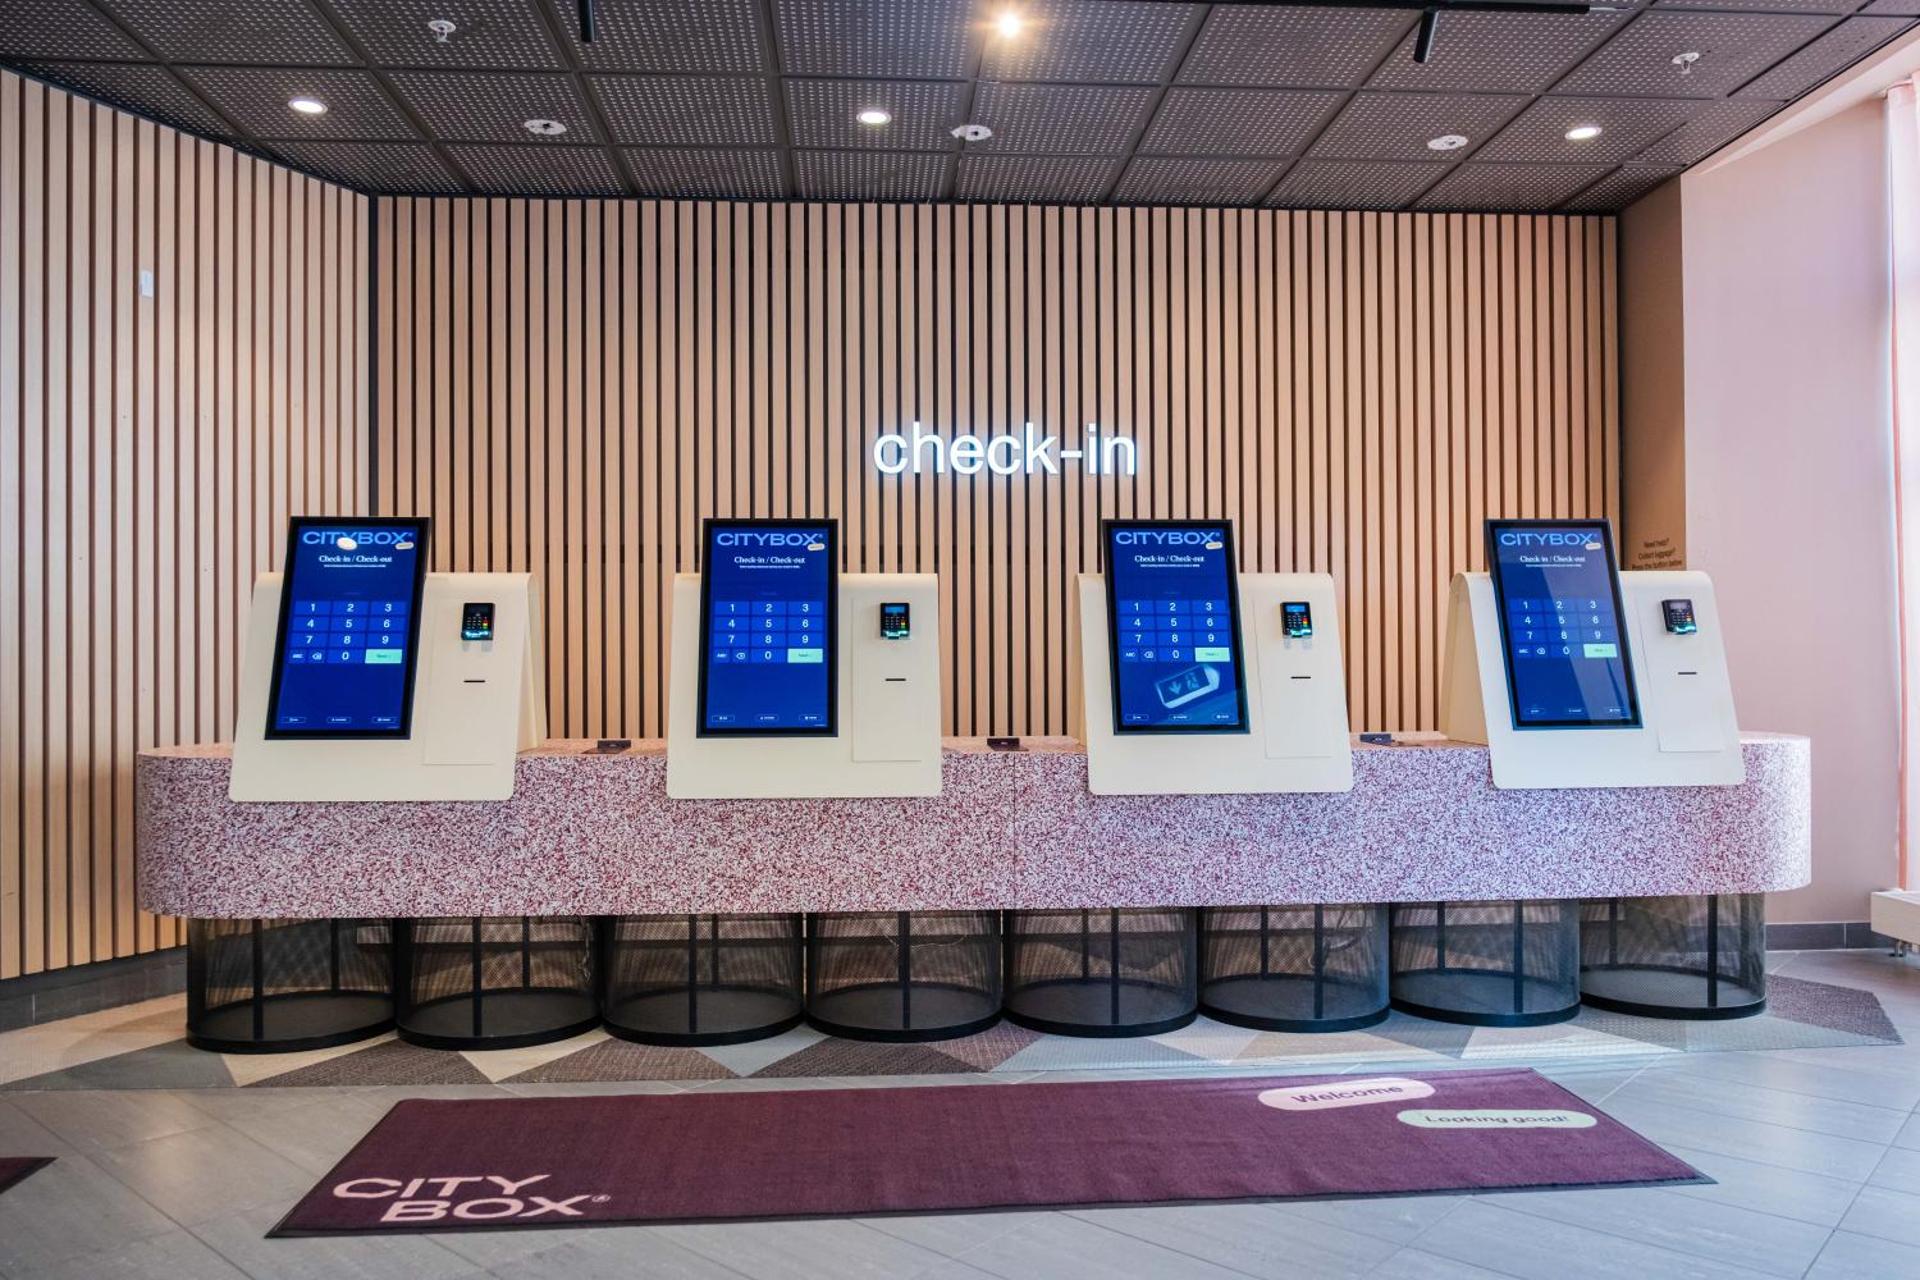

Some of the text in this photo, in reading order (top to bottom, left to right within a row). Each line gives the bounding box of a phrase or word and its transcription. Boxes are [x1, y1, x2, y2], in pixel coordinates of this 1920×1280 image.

[873, 421, 1136, 475] check-in
[310, 604, 392, 612] 1 2 3
[730, 604, 808, 612] 1 2 3
[1134, 603, 1212, 611] 1 2 3
[307, 620, 390, 628] 4 5 6
[728, 620, 808, 628] 4 5 6
[306, 636, 389, 644] 7 8 9
[1290, 1084, 1404, 1103] Welcome
[1425, 1114, 1509, 1125] Looking
[332, 1174, 552, 1199] CITY
